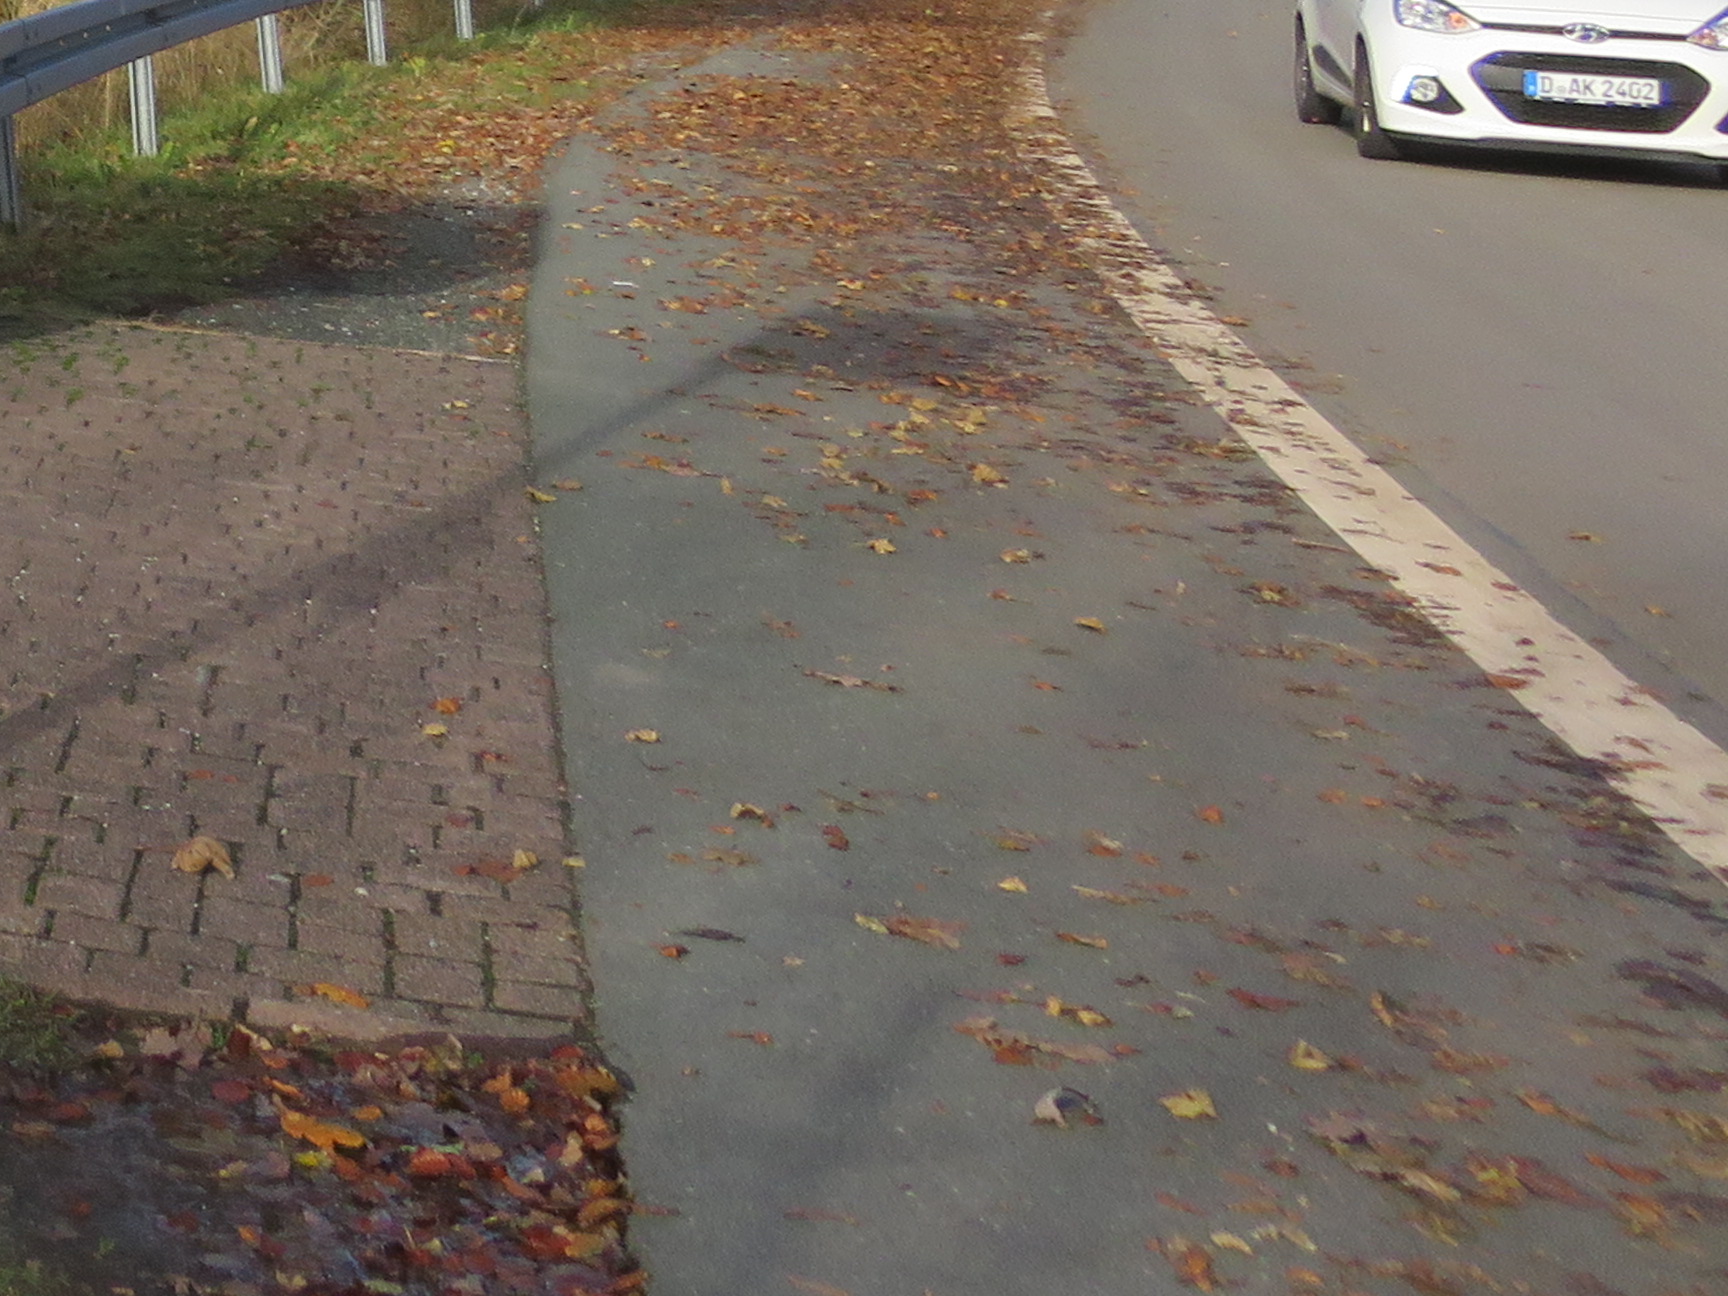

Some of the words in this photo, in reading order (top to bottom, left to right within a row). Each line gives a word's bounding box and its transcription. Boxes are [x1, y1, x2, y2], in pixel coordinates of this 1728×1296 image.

[1540, 75, 1553, 94] D
[1568, 78, 1596, 97] AK
[1601, 80, 1655, 100] 2402
